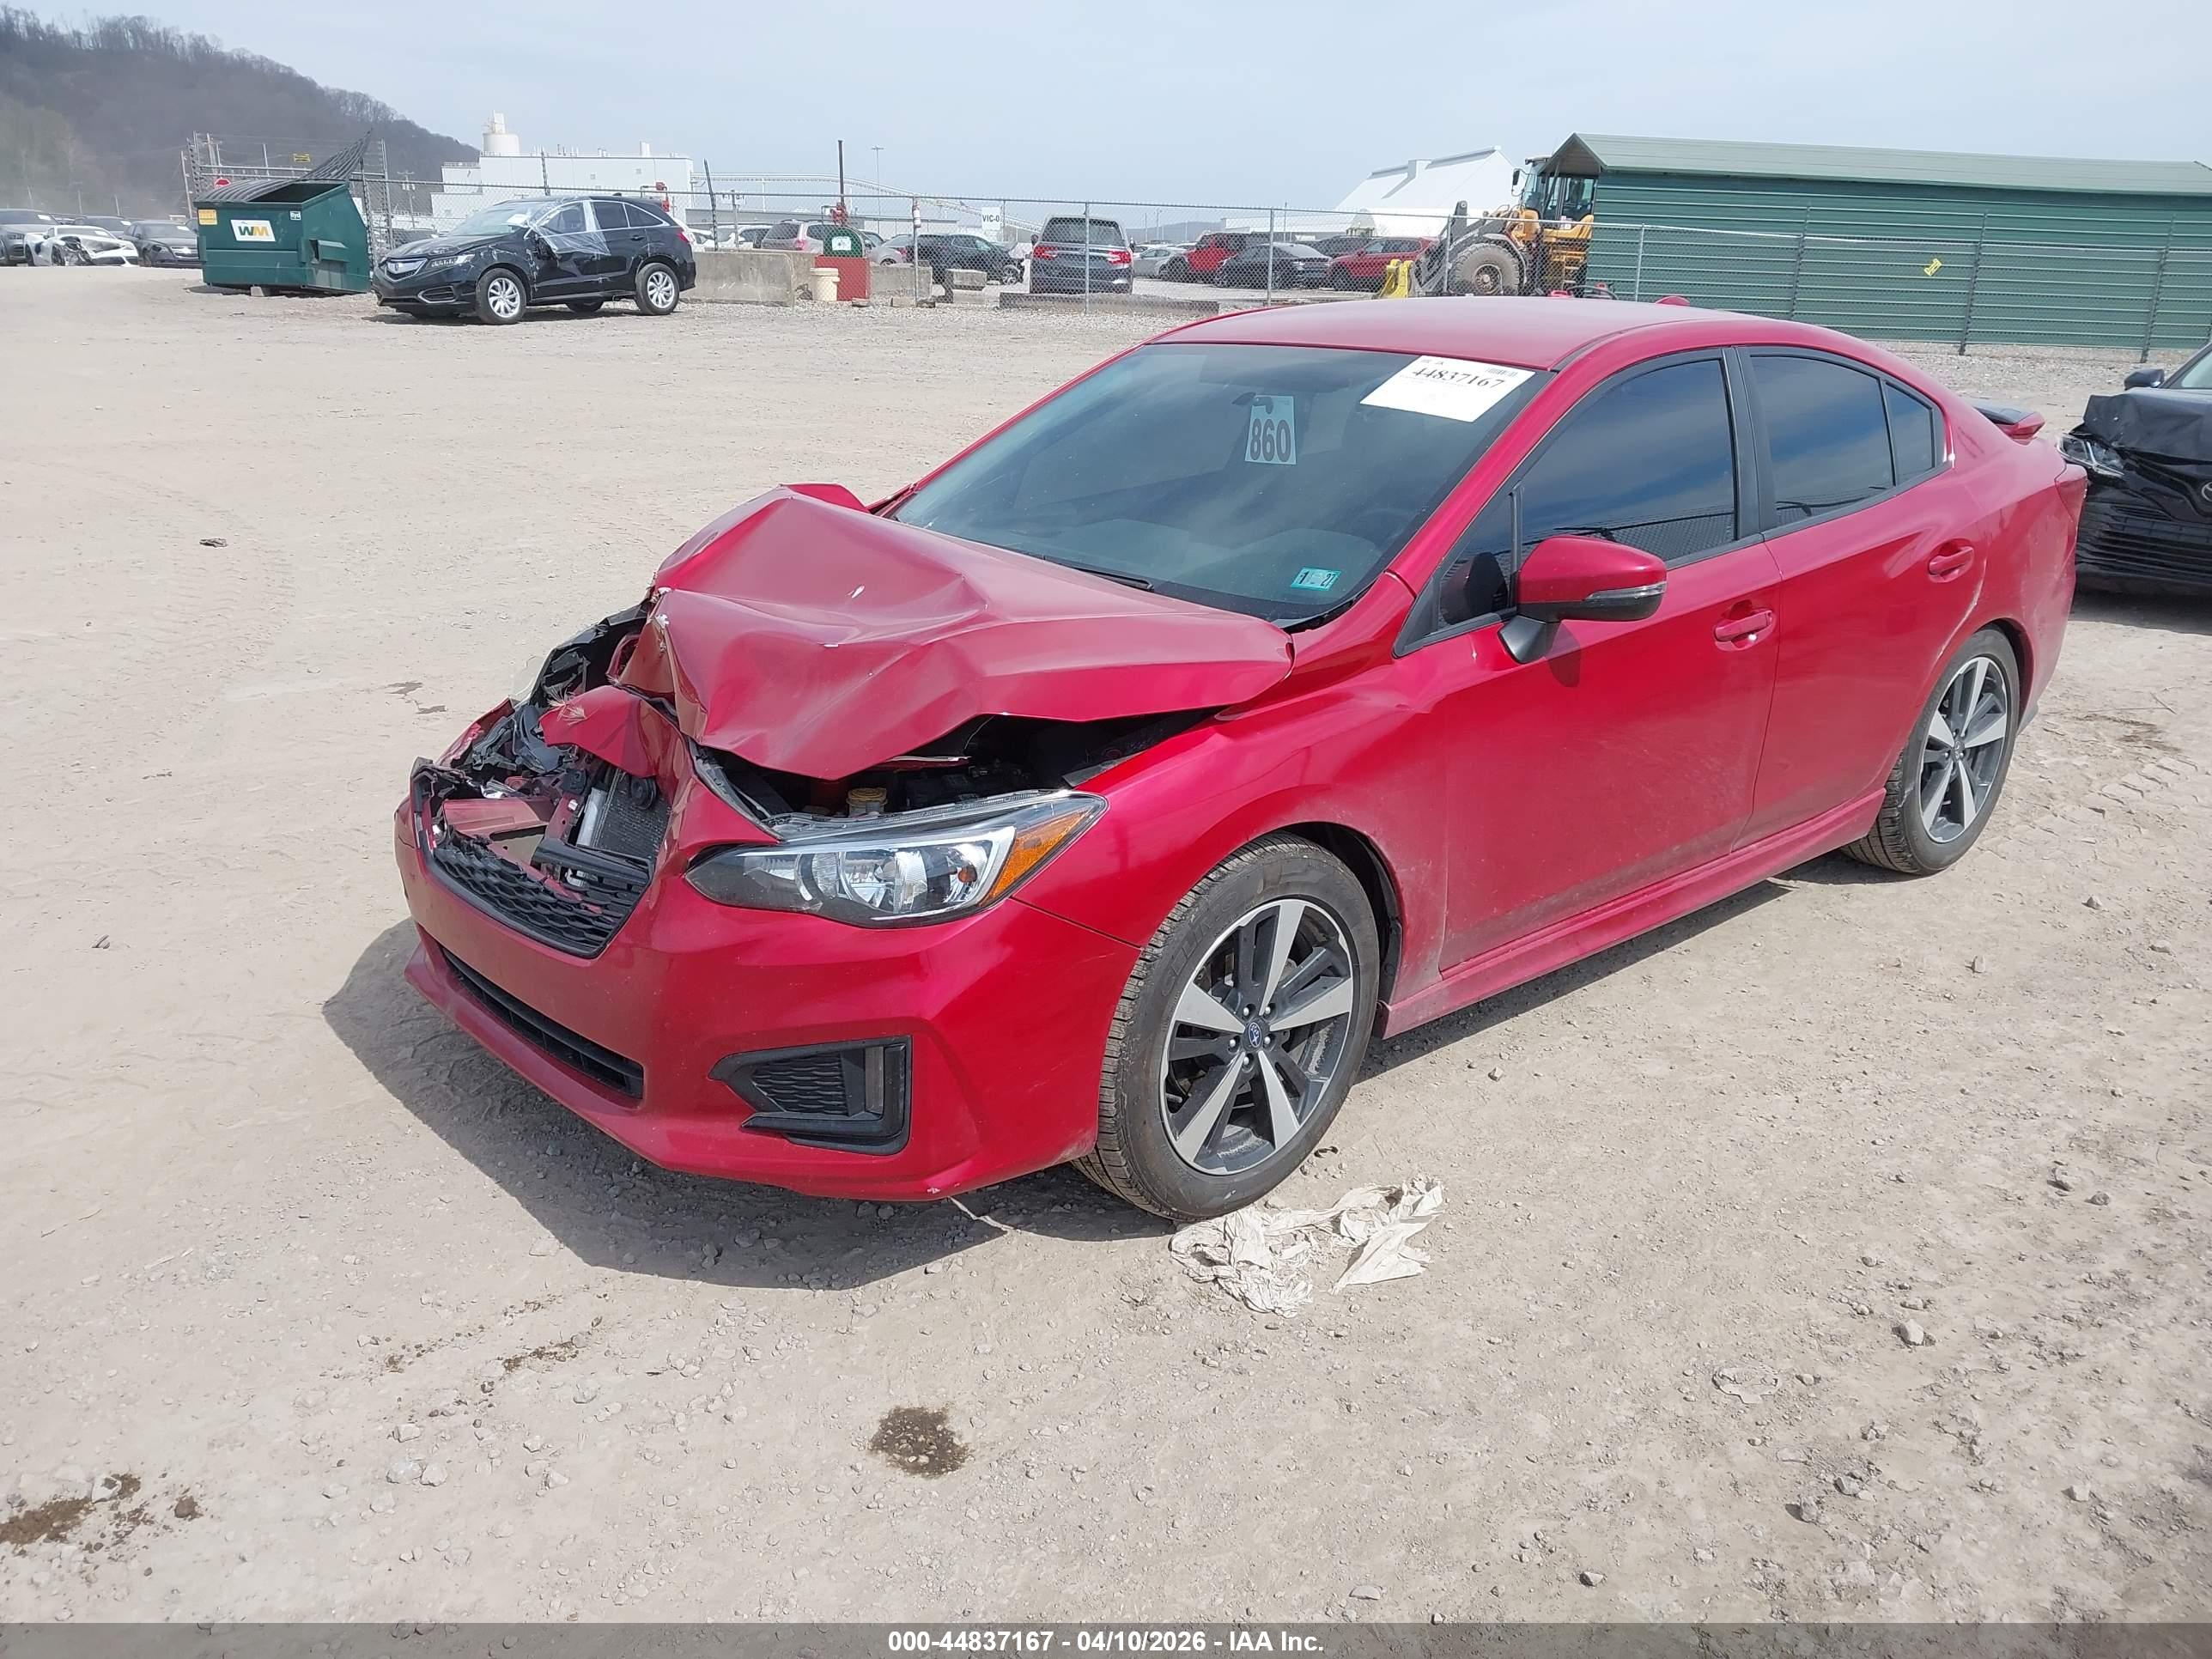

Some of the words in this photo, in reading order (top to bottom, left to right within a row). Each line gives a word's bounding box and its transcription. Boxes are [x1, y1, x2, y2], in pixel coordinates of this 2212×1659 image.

[238, 226, 270, 237] WM
[1412, 367, 1506, 389] 44837167
[1249, 417, 1291, 463] 860
